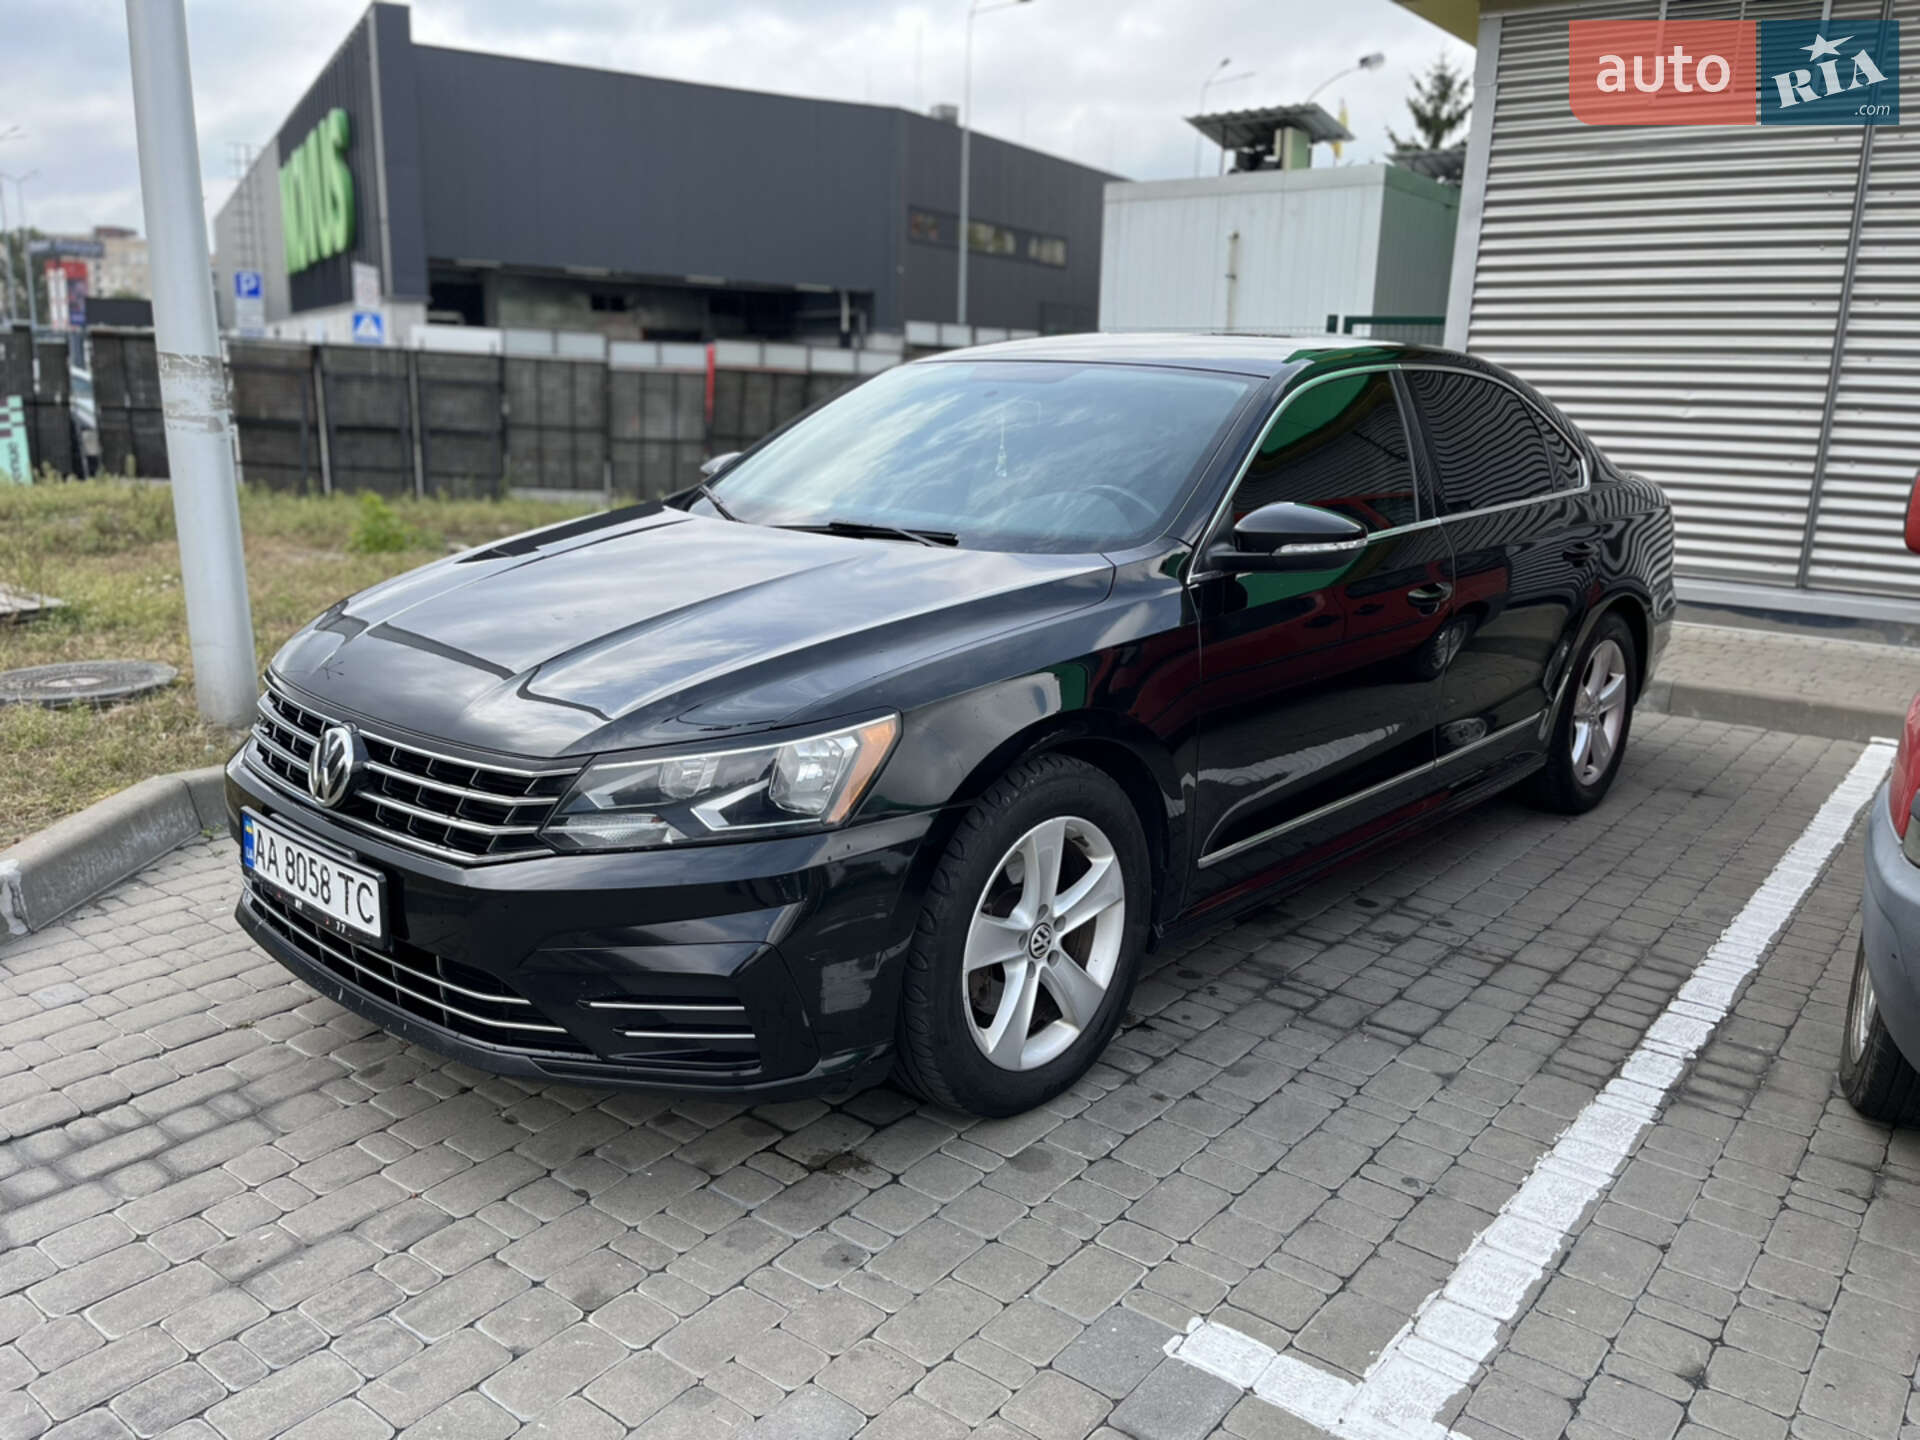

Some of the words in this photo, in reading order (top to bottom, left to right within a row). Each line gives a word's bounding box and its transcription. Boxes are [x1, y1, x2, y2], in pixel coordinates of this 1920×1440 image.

[255, 829, 279, 878] AA
[285, 846, 331, 905] 8058
[337, 871, 374, 924] TC
